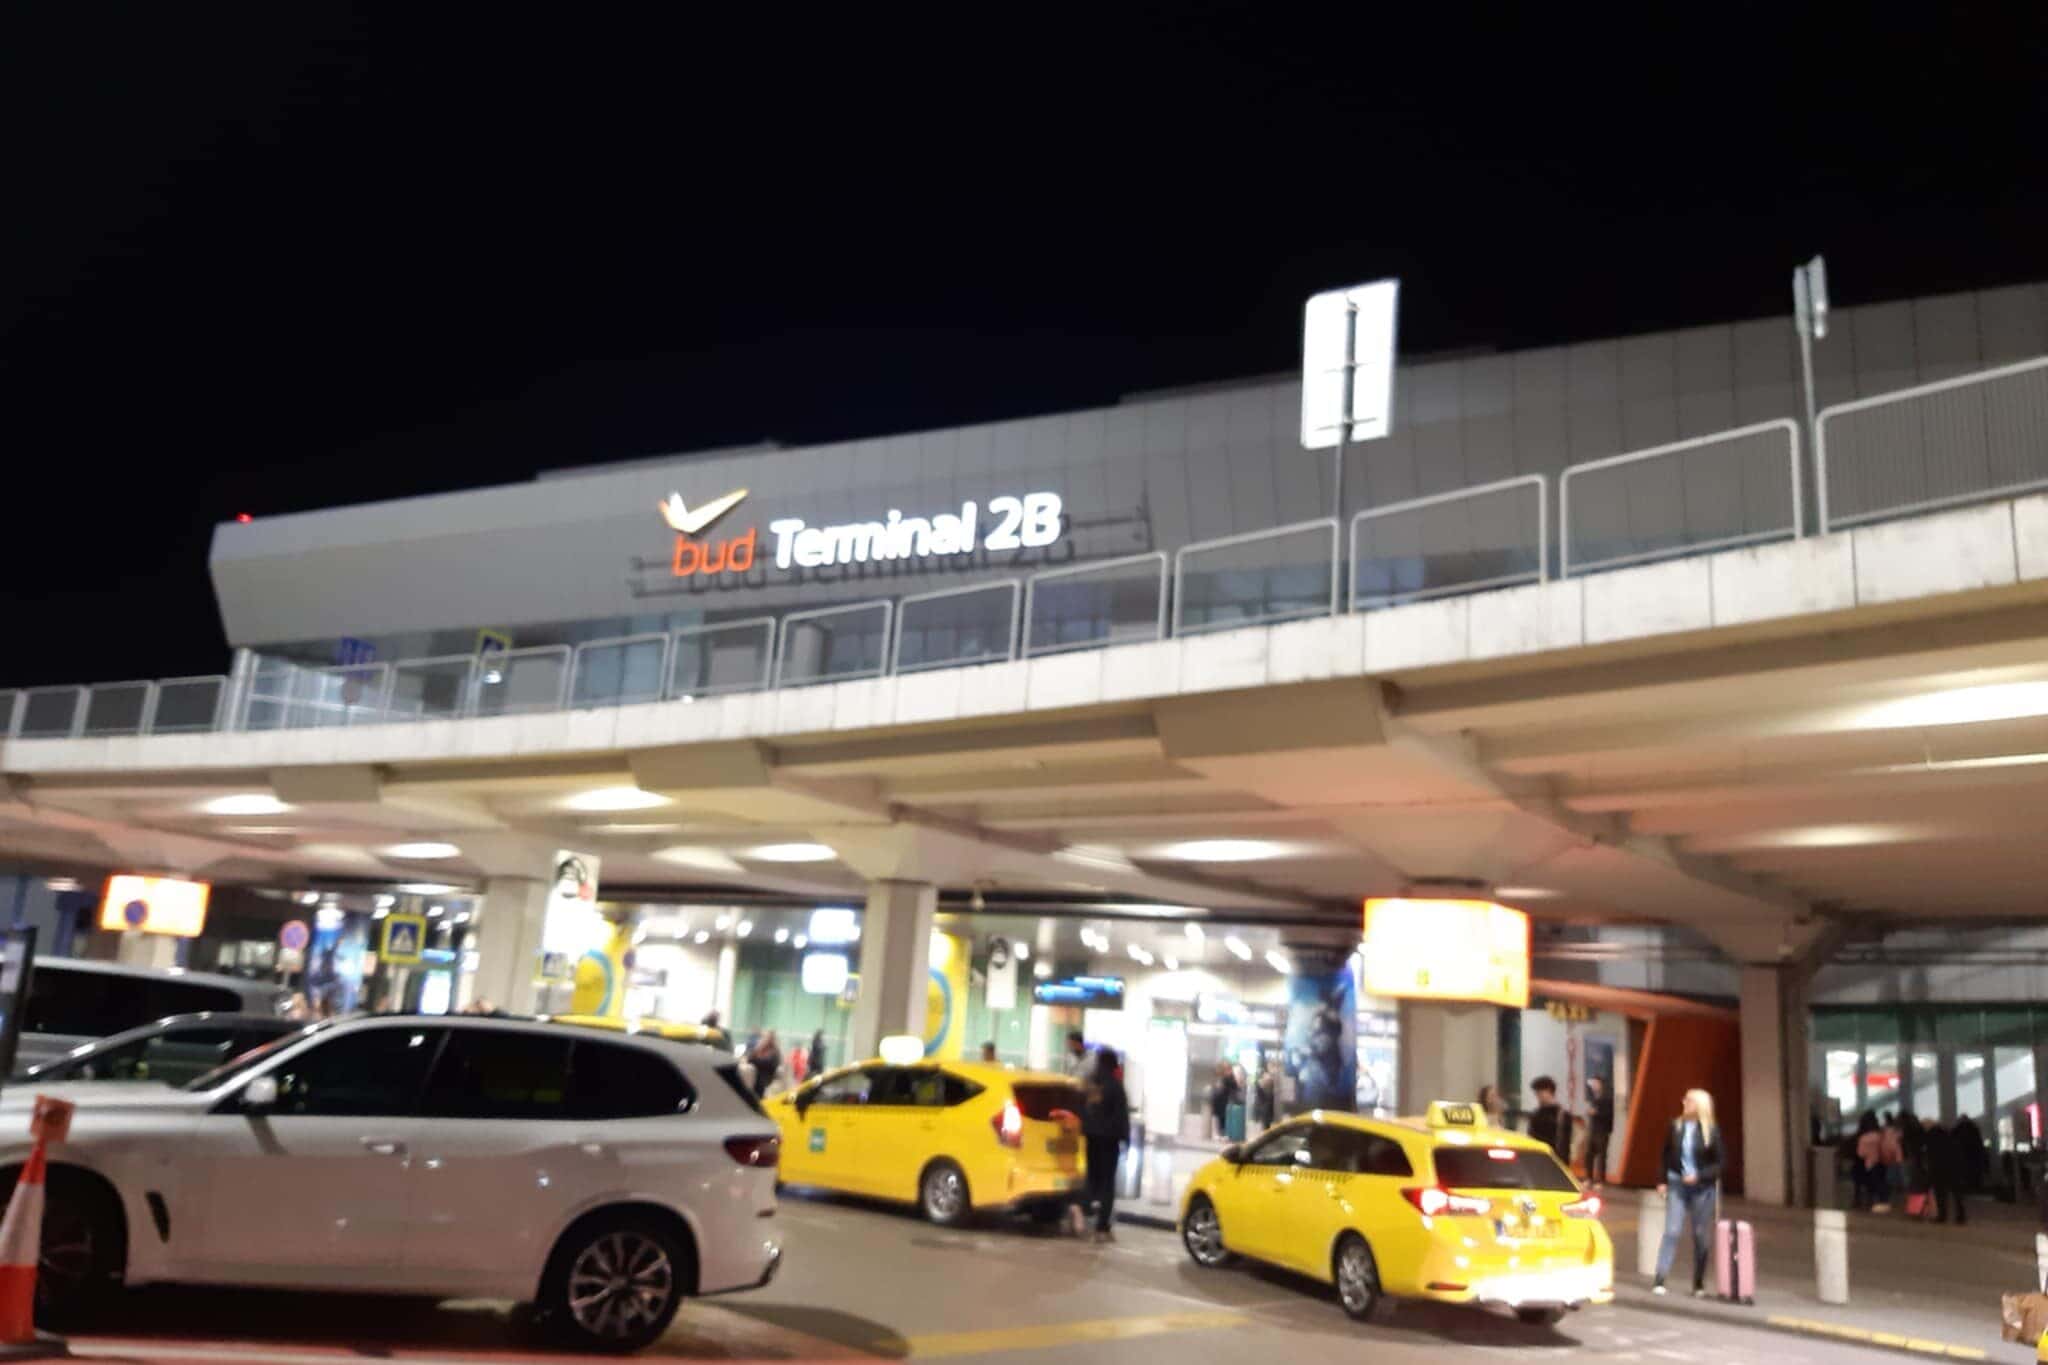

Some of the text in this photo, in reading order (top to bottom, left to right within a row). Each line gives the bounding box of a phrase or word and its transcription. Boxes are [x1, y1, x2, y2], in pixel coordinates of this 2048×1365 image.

[672, 492, 1063, 577] bud Terminal 2B
